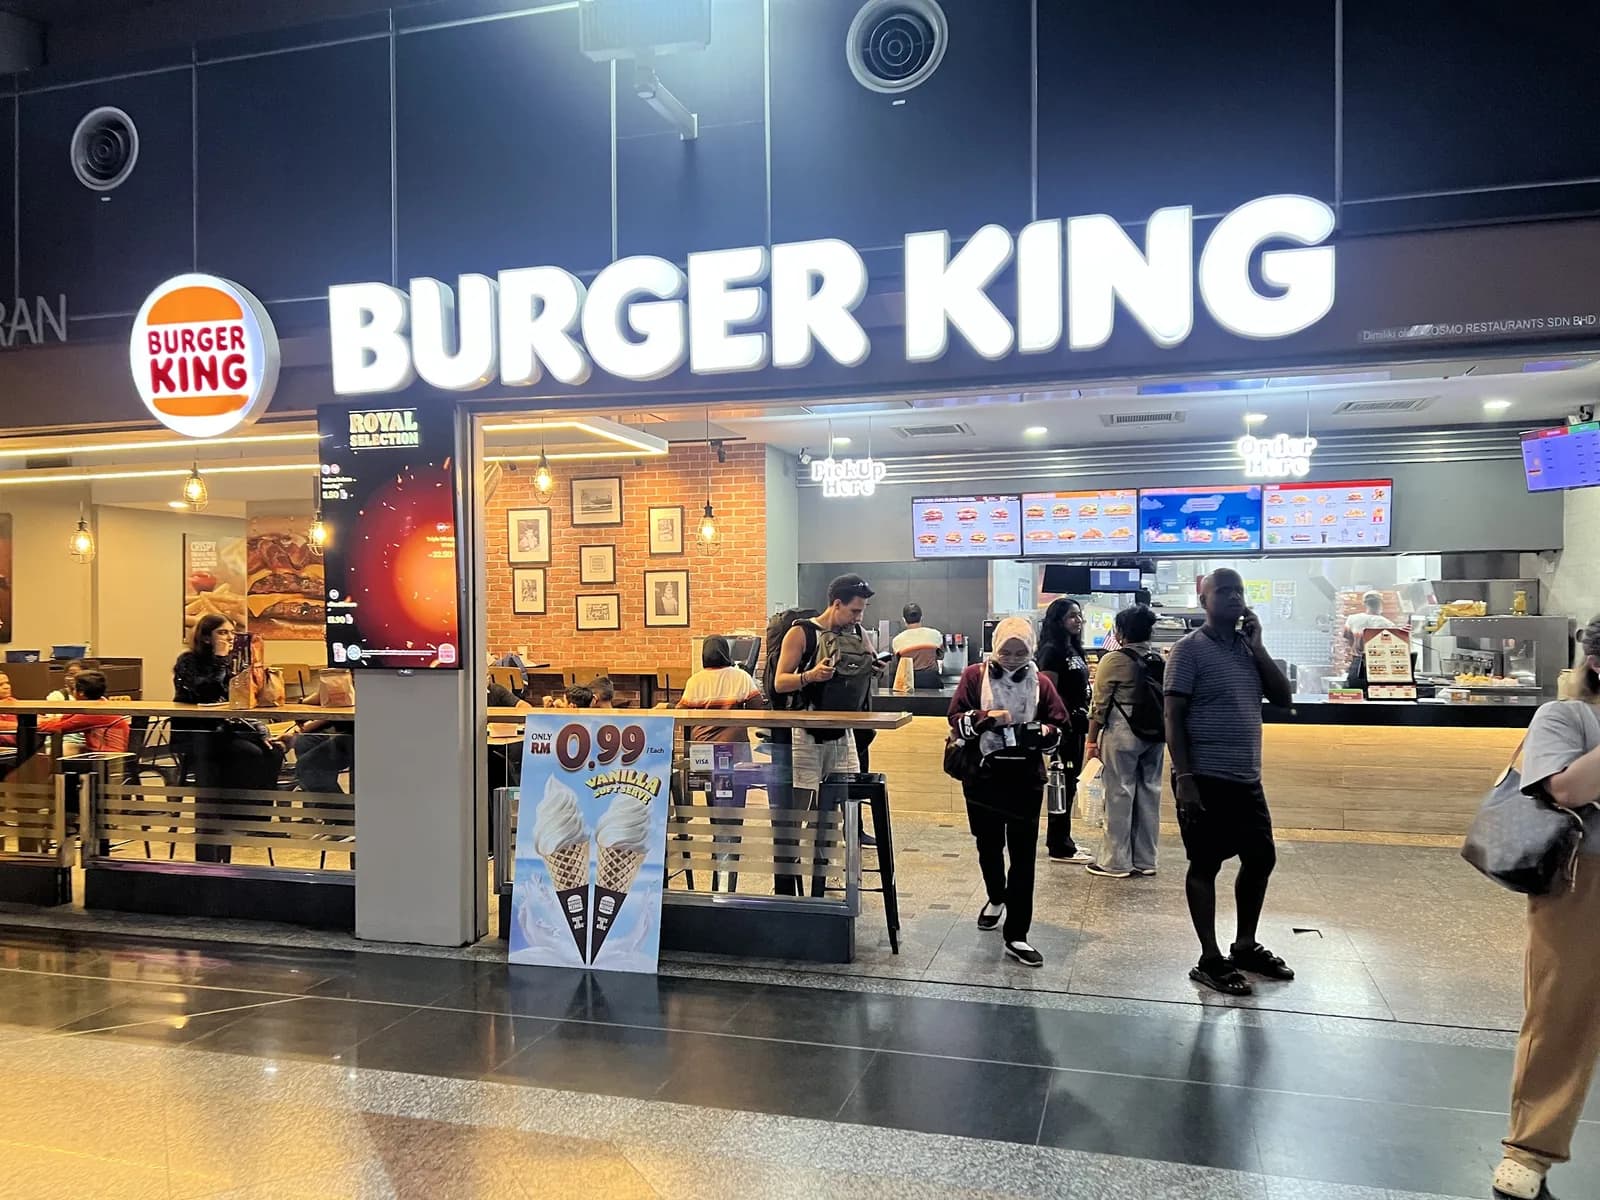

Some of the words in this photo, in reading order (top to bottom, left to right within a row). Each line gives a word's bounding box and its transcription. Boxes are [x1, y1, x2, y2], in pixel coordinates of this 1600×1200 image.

[328, 238, 871, 395] BURGER
[905, 193, 1336, 362] KING
[1421, 323, 1463, 337] OSMO
[1466, 318, 1543, 333] RESTAURANTS
[1547, 316, 1570, 328] SDN
[1573, 314, 1596, 326] BHD
[148, 325, 245, 355] BURGER
[150, 354, 247, 393] KING
[349, 411, 418, 433] ROYAL
[349, 432, 419, 447] SELECTION
[531, 733, 553, 741] ONLY
[531, 742, 551, 754] RM
[556, 722, 646, 771] 0.99
[585, 769, 661, 797] VANILLA
[593, 785, 620, 799] SOFT
[620, 785, 652, 805] SERVE
